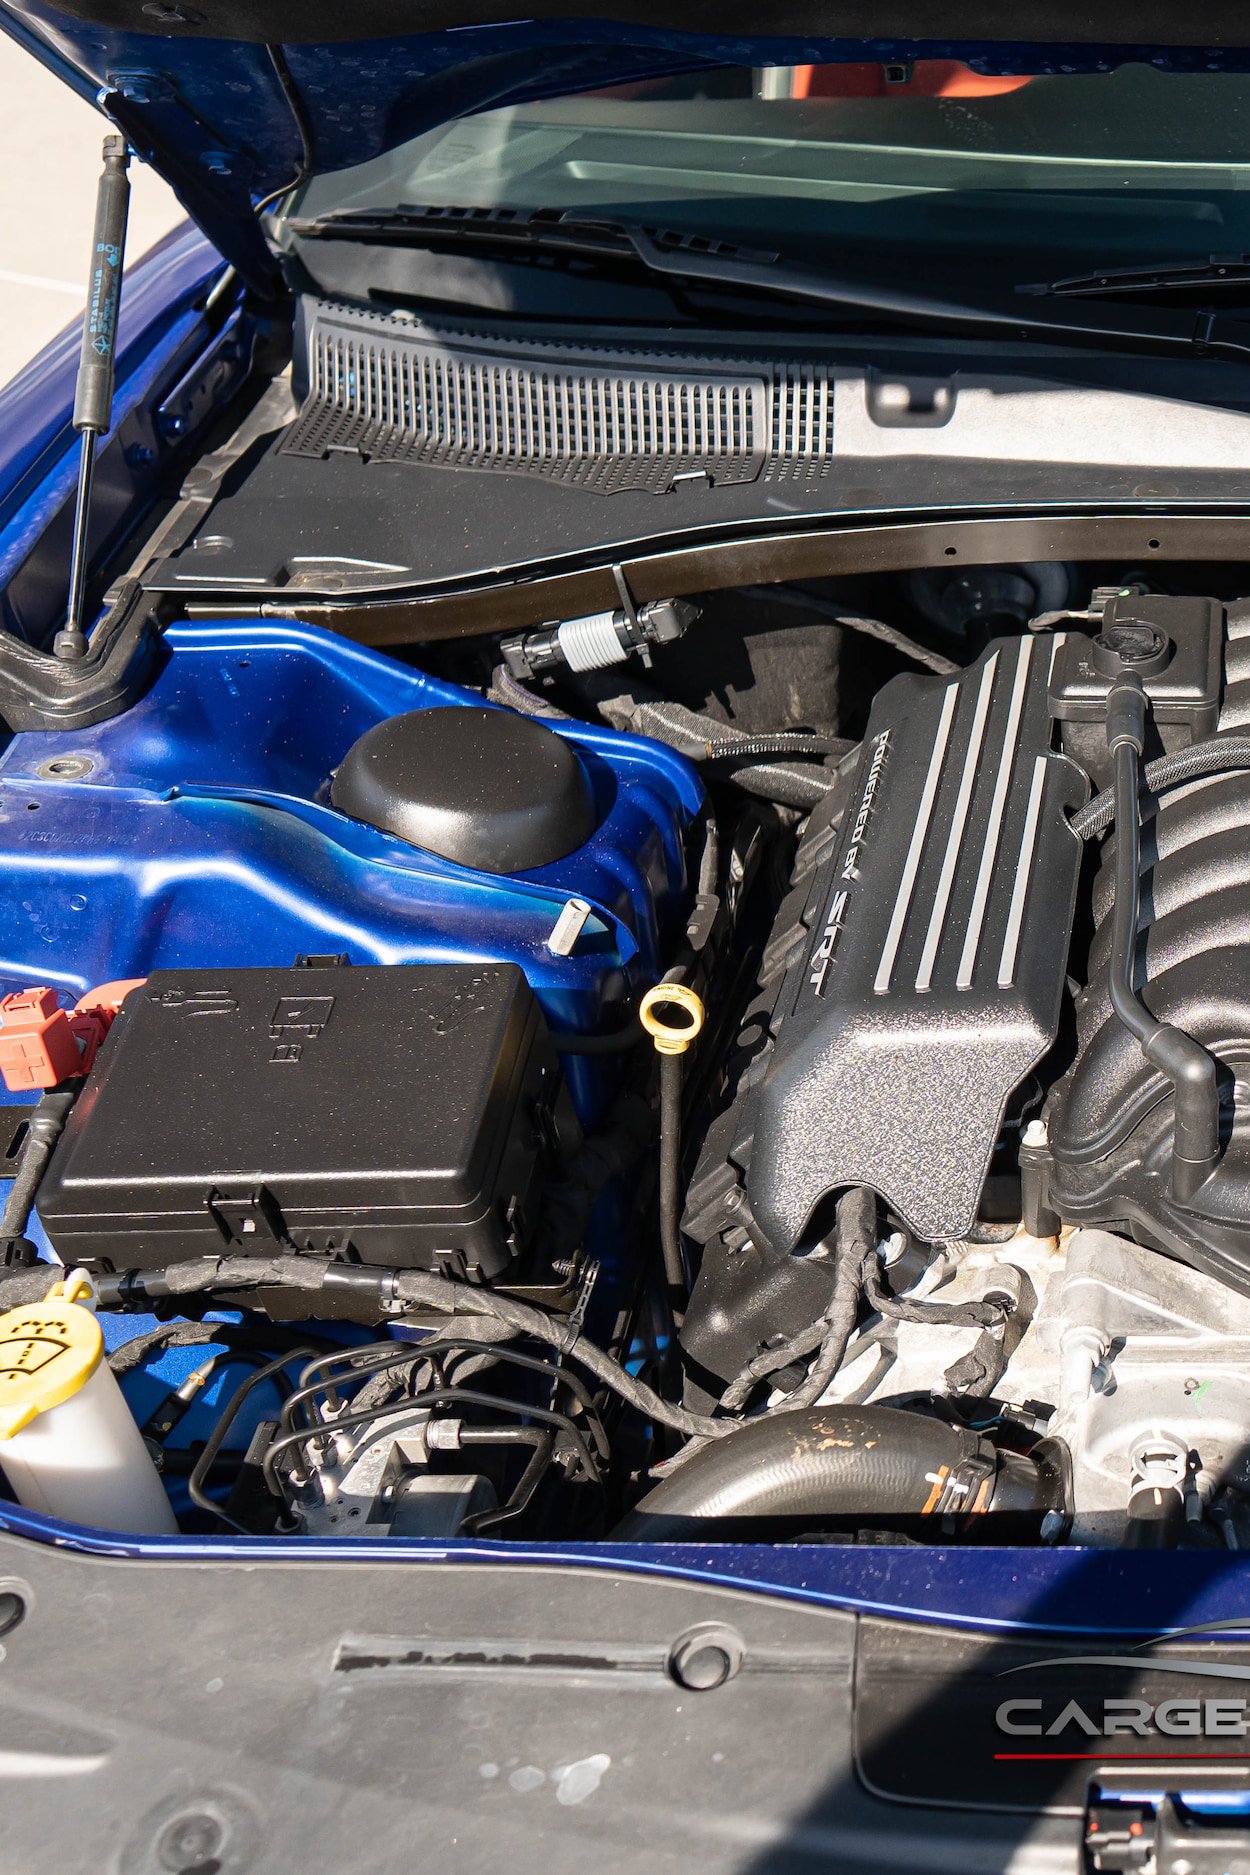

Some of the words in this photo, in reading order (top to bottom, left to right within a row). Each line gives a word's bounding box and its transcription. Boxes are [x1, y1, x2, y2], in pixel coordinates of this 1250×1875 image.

[90, 269, 103, 332] STABILUS
[851, 729, 890, 844] POWERED
[841, 846, 859, 880] BY
[810, 890, 848, 996] SRT
